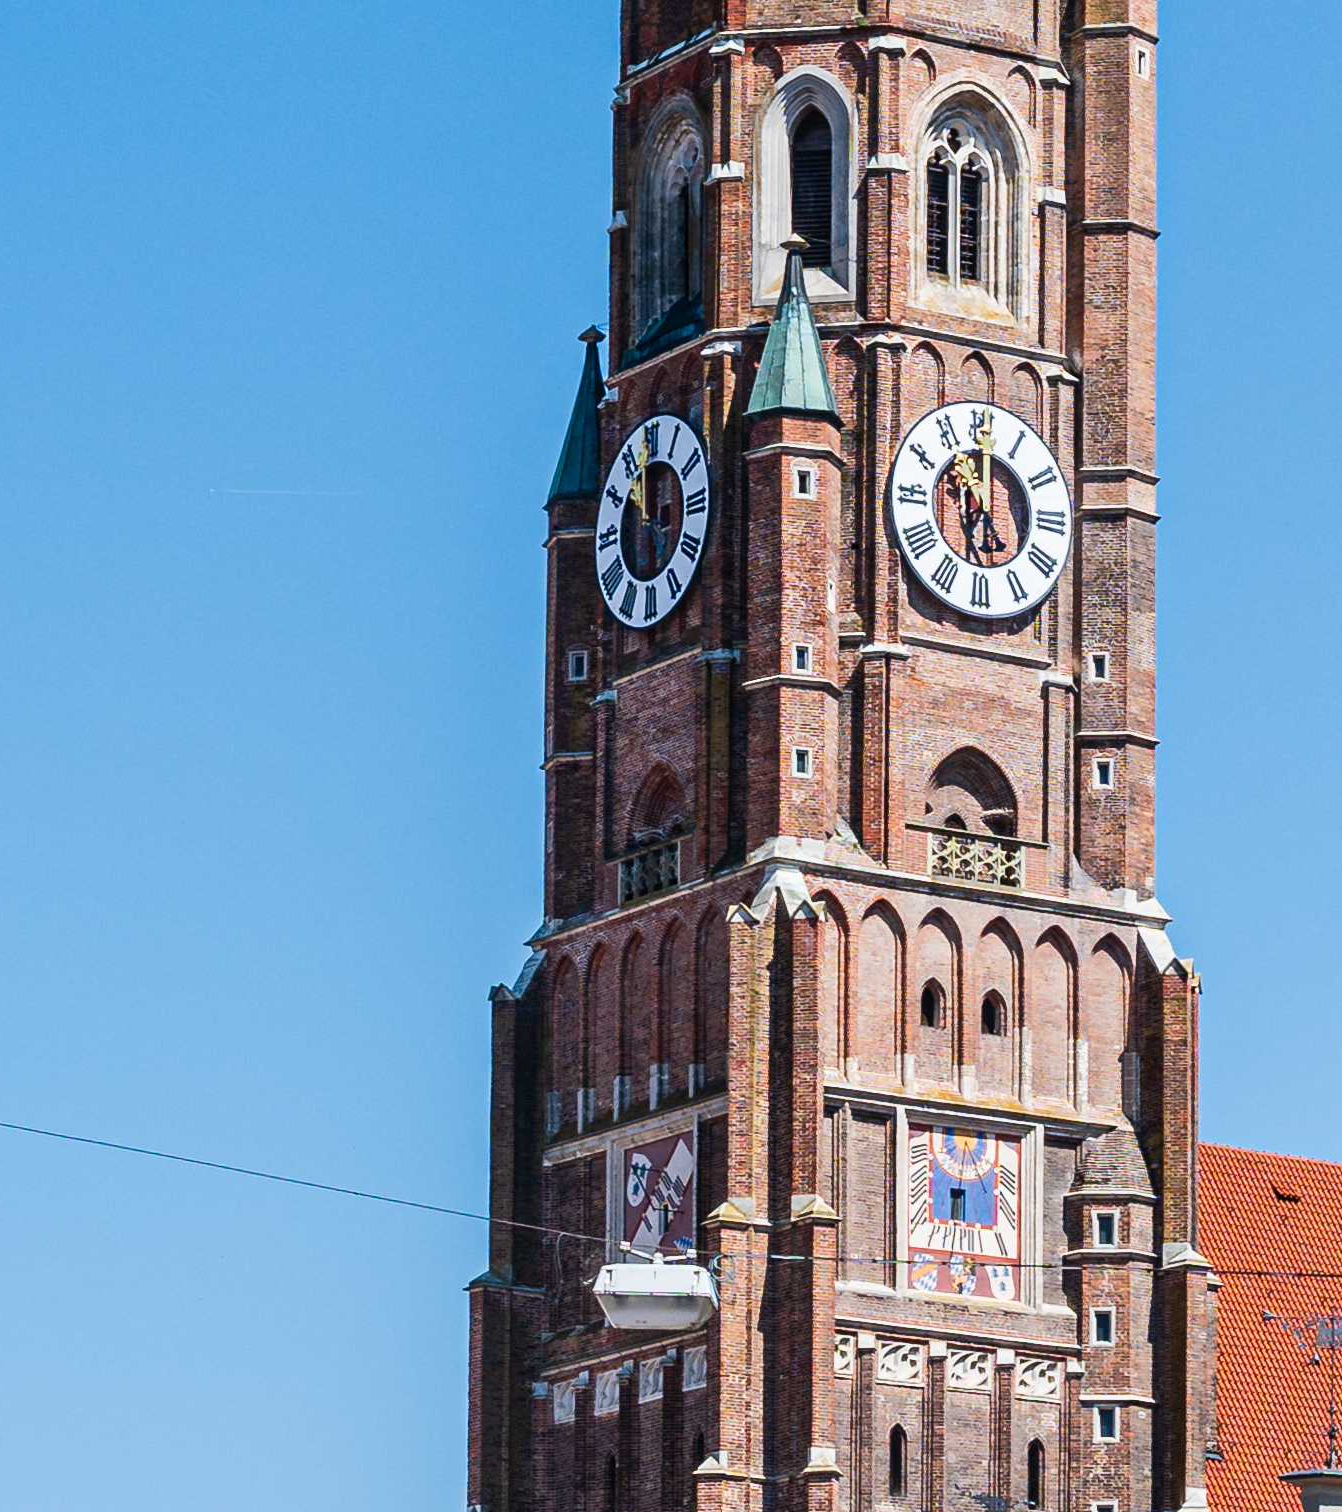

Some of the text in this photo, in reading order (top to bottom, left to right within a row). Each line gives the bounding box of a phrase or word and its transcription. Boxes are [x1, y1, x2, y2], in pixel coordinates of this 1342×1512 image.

[909, 443, 935, 470] X
[1009, 430, 1026, 459] I
[1028, 466, 1057, 491] II
[686, 486, 706, 516] III
[897, 483, 927, 507] IX
[1036, 509, 1066, 536] III
